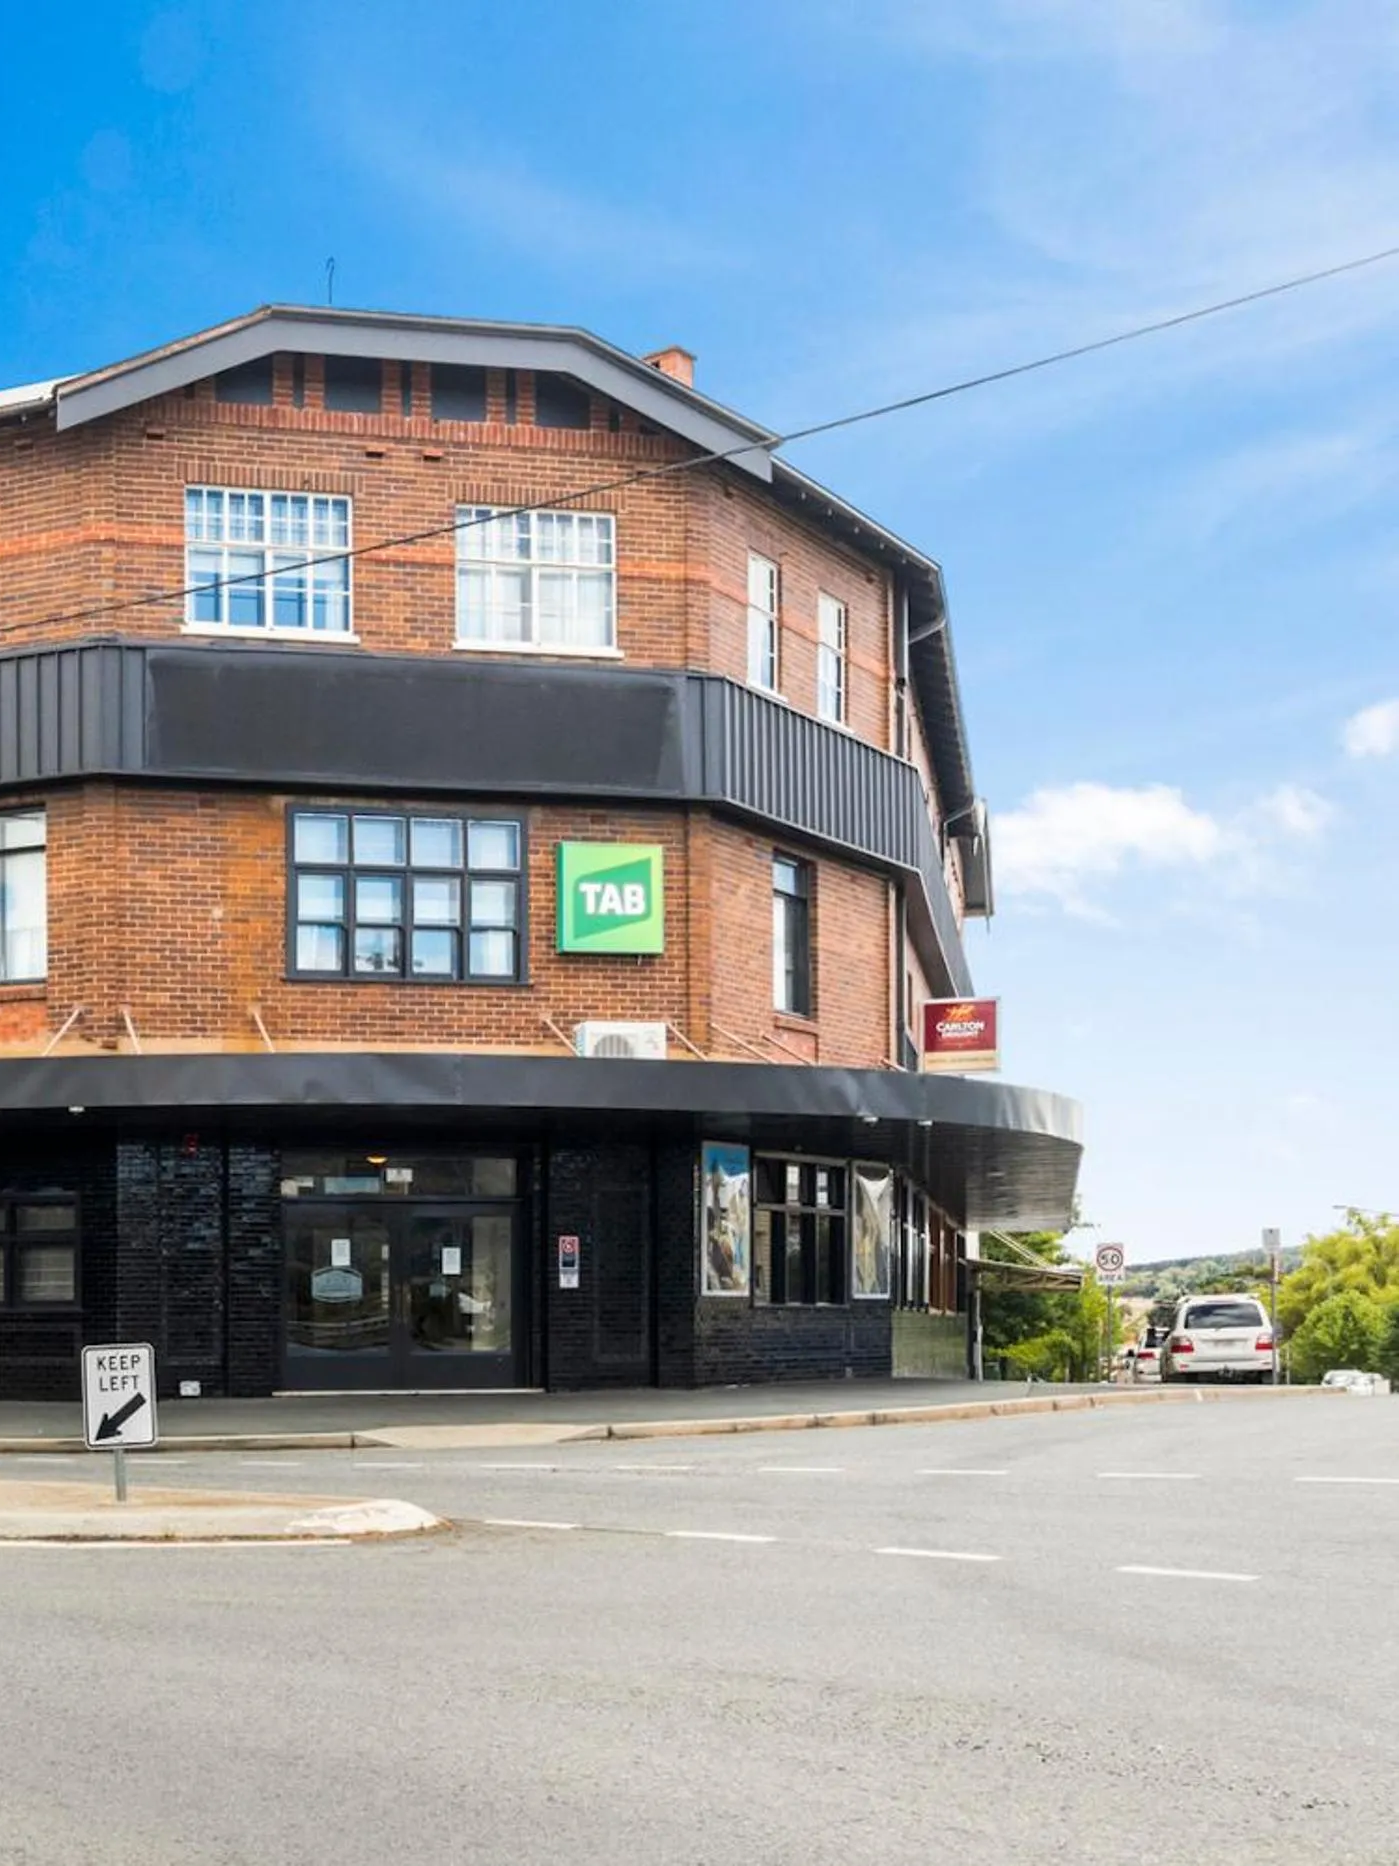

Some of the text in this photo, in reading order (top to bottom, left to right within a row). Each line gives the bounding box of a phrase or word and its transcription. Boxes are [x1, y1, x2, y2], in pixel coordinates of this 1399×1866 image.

[579, 882, 645, 915] TAB
[936, 1020, 985, 1033] CARLTON
[1100, 1253, 1120, 1266] 50
[96, 1354, 141, 1371] KEEP
[99, 1374, 140, 1392] LEFT
